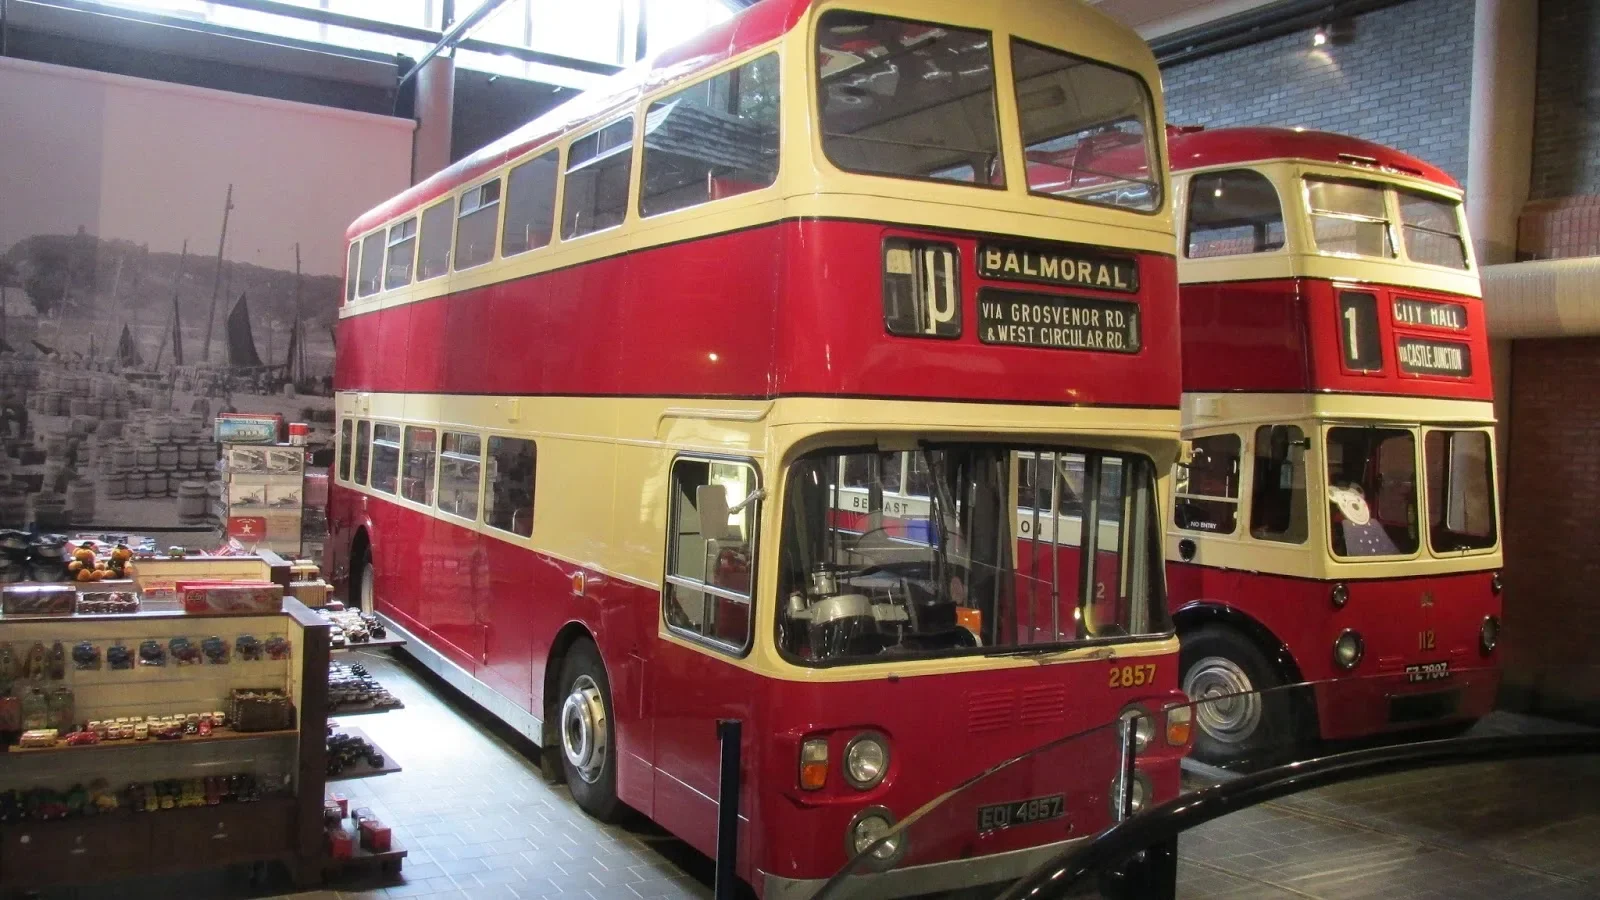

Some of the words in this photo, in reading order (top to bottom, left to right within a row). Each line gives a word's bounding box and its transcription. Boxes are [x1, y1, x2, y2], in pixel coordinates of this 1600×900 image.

[985, 249, 1128, 289] BALMORAL
[982, 302, 1003, 320] VIA
[1011, 303, 1100, 327] GROSVENOR
[1105, 310, 1127, 329] RD.
[1393, 303, 1422, 323] CITY
[1430, 307, 1460, 328] HALL
[986, 327, 996, 341] &
[997, 324, 1034, 344] WEST
[1040, 328, 1104, 348] CIRCULAR
[1106, 331, 1127, 349] RD.
[1344, 307, 1358, 360] 1
[1407, 343, 1433, 368] CASTLE
[1433, 347, 1462, 370] JUNCTION
[1109, 664, 1156, 688] 2857
[1016, 796, 1063, 822] 4857
